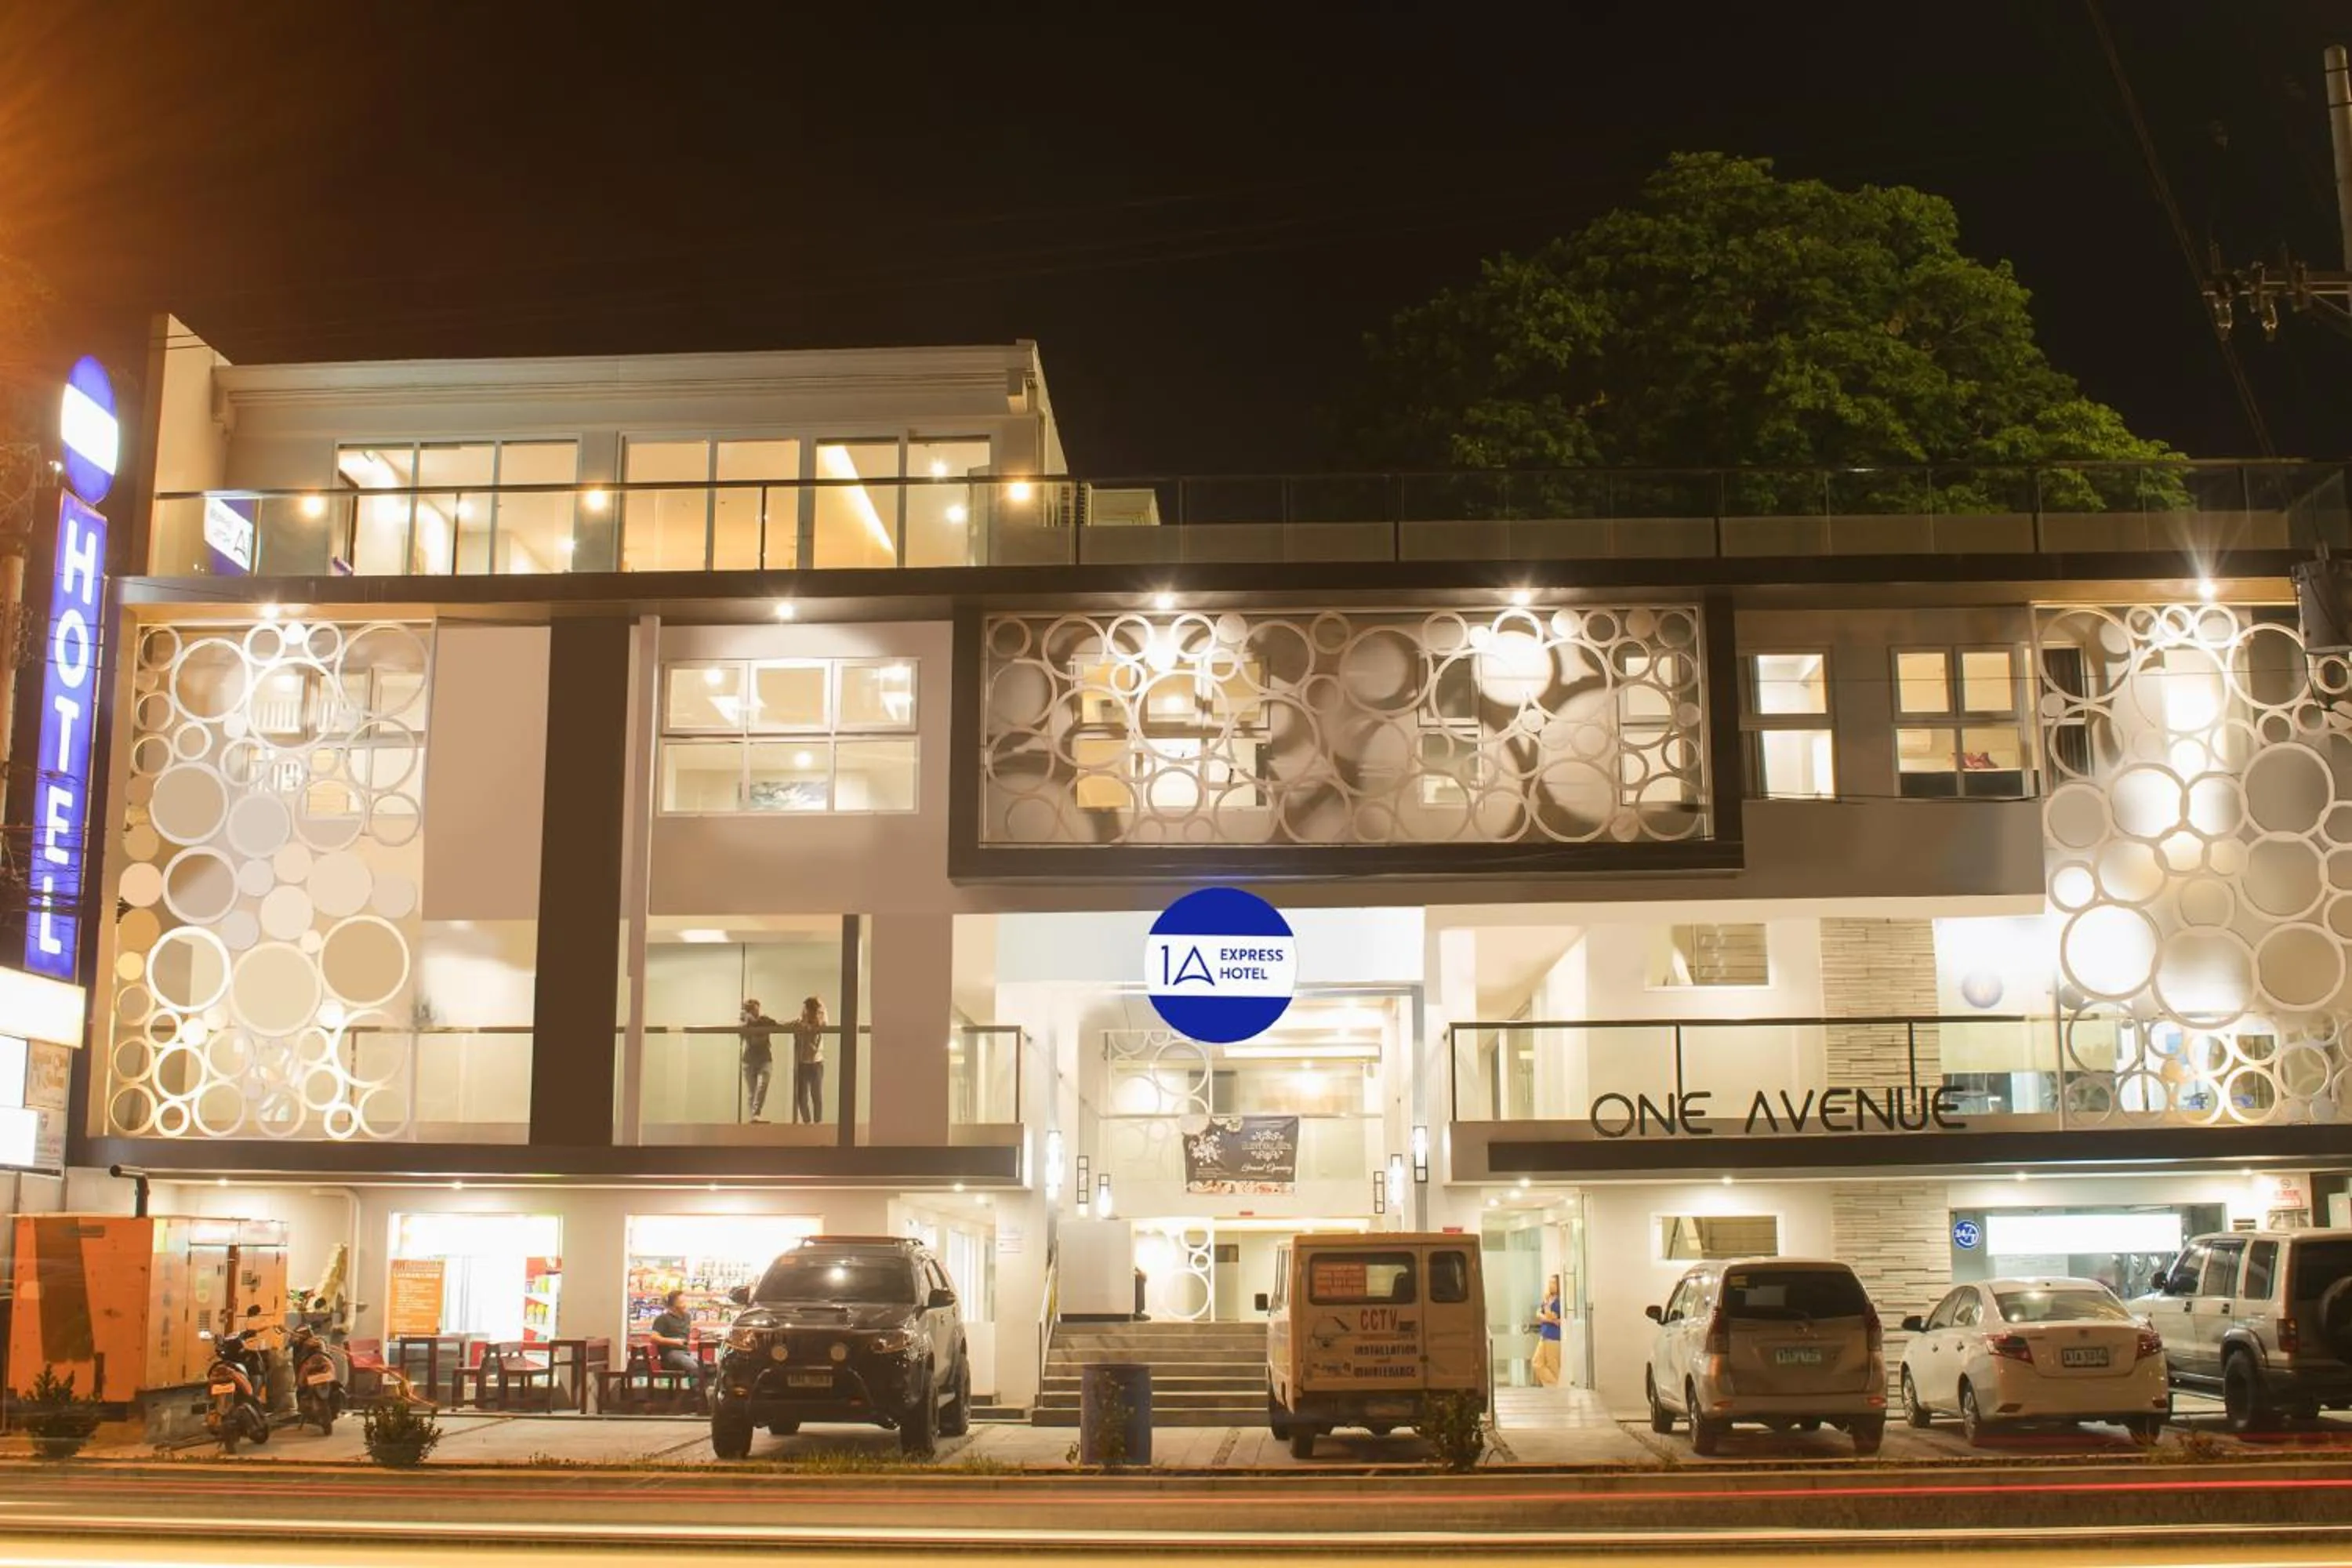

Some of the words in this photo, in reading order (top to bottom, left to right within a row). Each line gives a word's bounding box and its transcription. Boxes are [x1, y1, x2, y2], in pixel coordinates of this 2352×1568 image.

[39, 519, 96, 955] HOTEL
[1161, 945, 1215, 985] 1A
[1220, 948, 1283, 961] EXPRESS
[1220, 967, 1268, 979] HOTEL
[1591, 1091, 1712, 1138] ONE
[1744, 1085, 1966, 1134] AVENUE
[1360, 1308, 1398, 1330] CCTV
